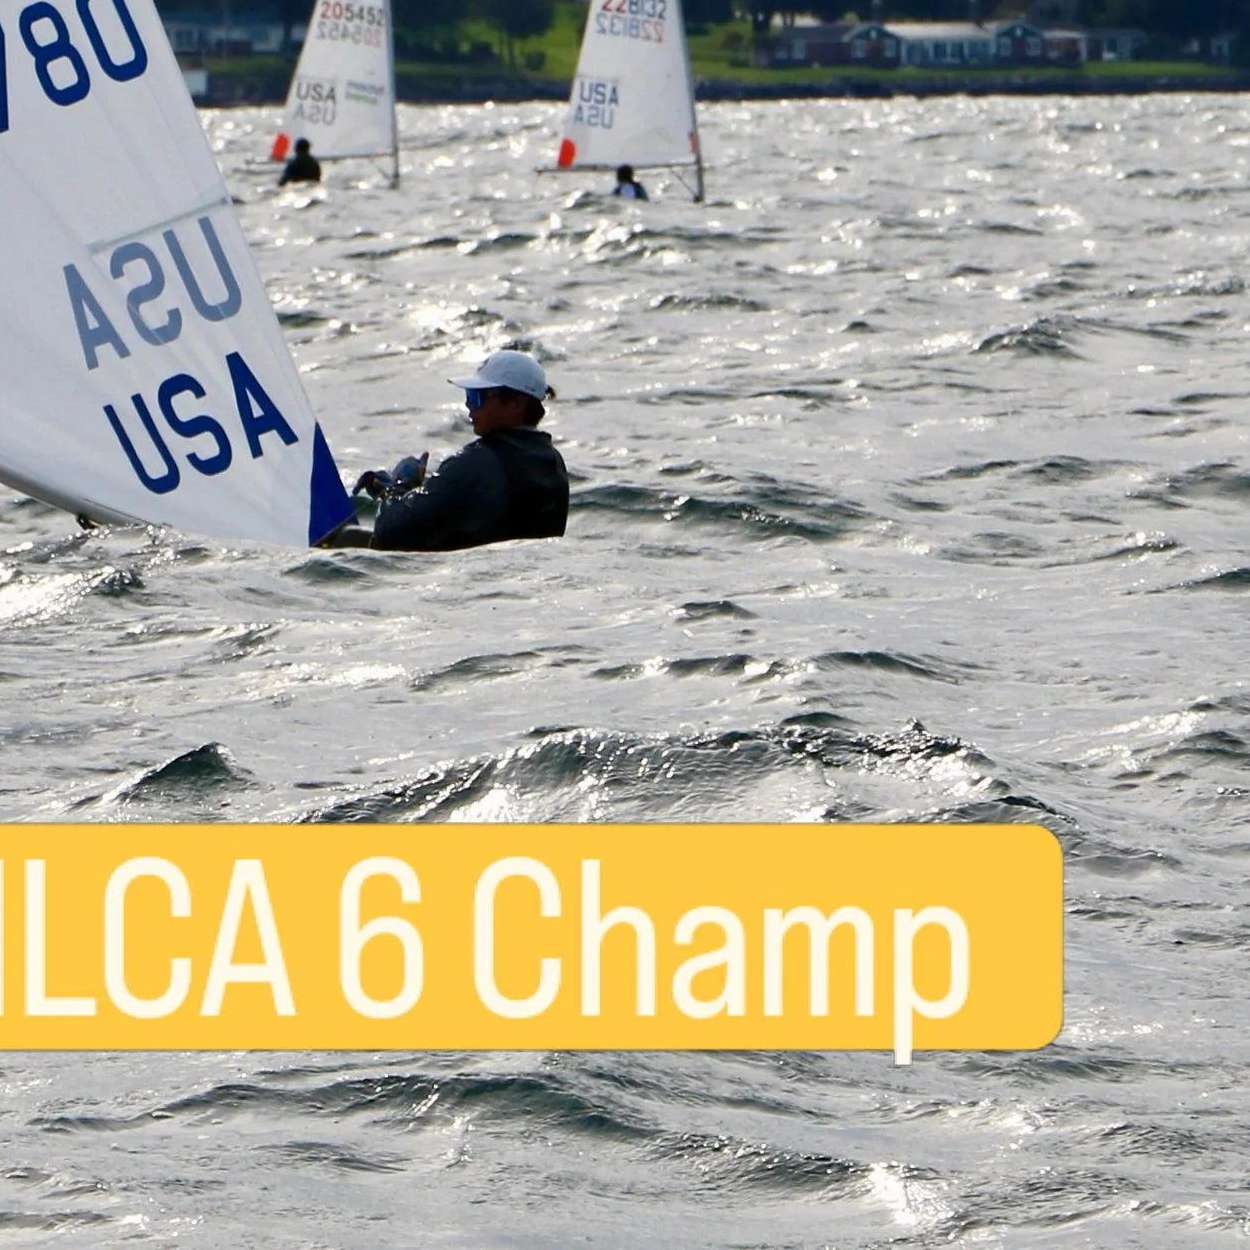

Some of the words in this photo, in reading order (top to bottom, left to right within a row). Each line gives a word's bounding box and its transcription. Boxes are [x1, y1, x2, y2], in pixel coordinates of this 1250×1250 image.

[320, 0, 384, 27] 205452
[296, 82, 336, 103] USA
[580, 81, 619, 107] USA
[103, 351, 299, 494] USA
